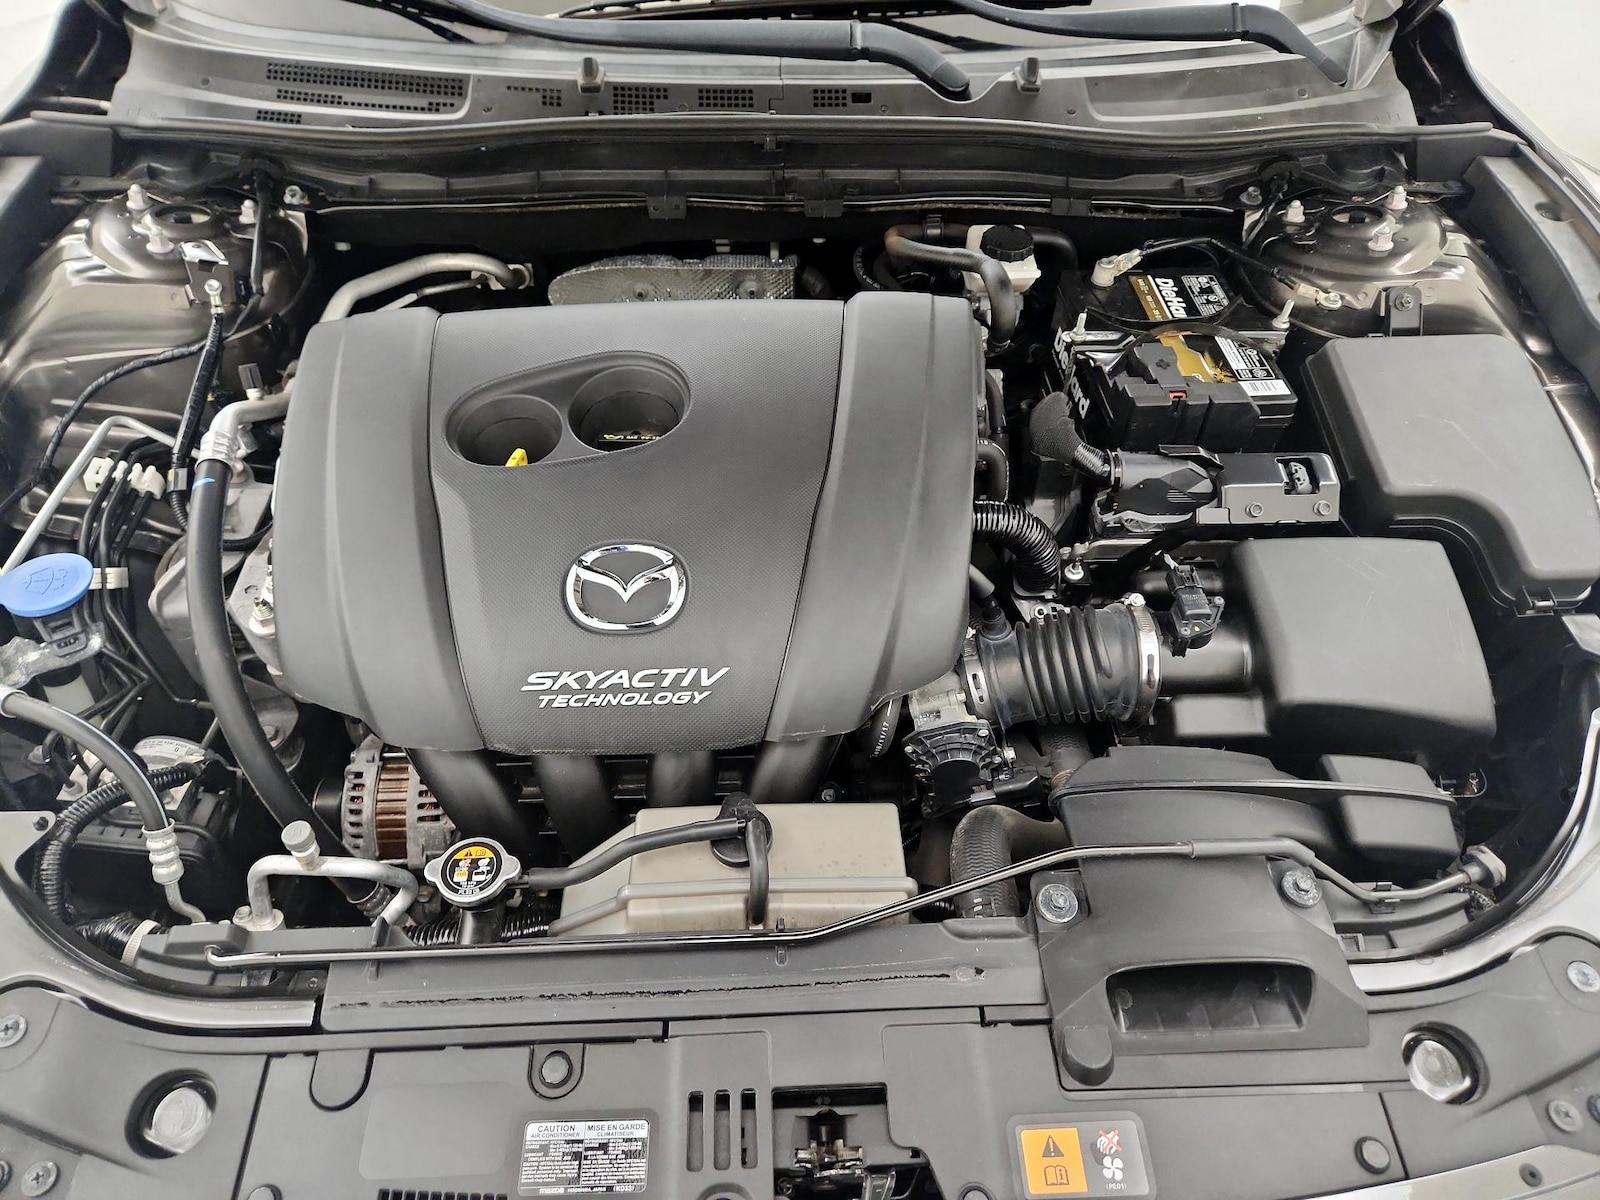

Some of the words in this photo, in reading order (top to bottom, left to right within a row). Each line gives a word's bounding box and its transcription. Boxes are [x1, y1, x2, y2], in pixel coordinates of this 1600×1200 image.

[1054, 326, 1090, 419] Dieard
[520, 667, 731, 691] SKYACTIV
[538, 691, 712, 708] TECHNOLOGY
[537, 1124, 576, 1132] CAUTION
[587, 1124, 606, 1132] MISE
[620, 1123, 646, 1131] GARDE
